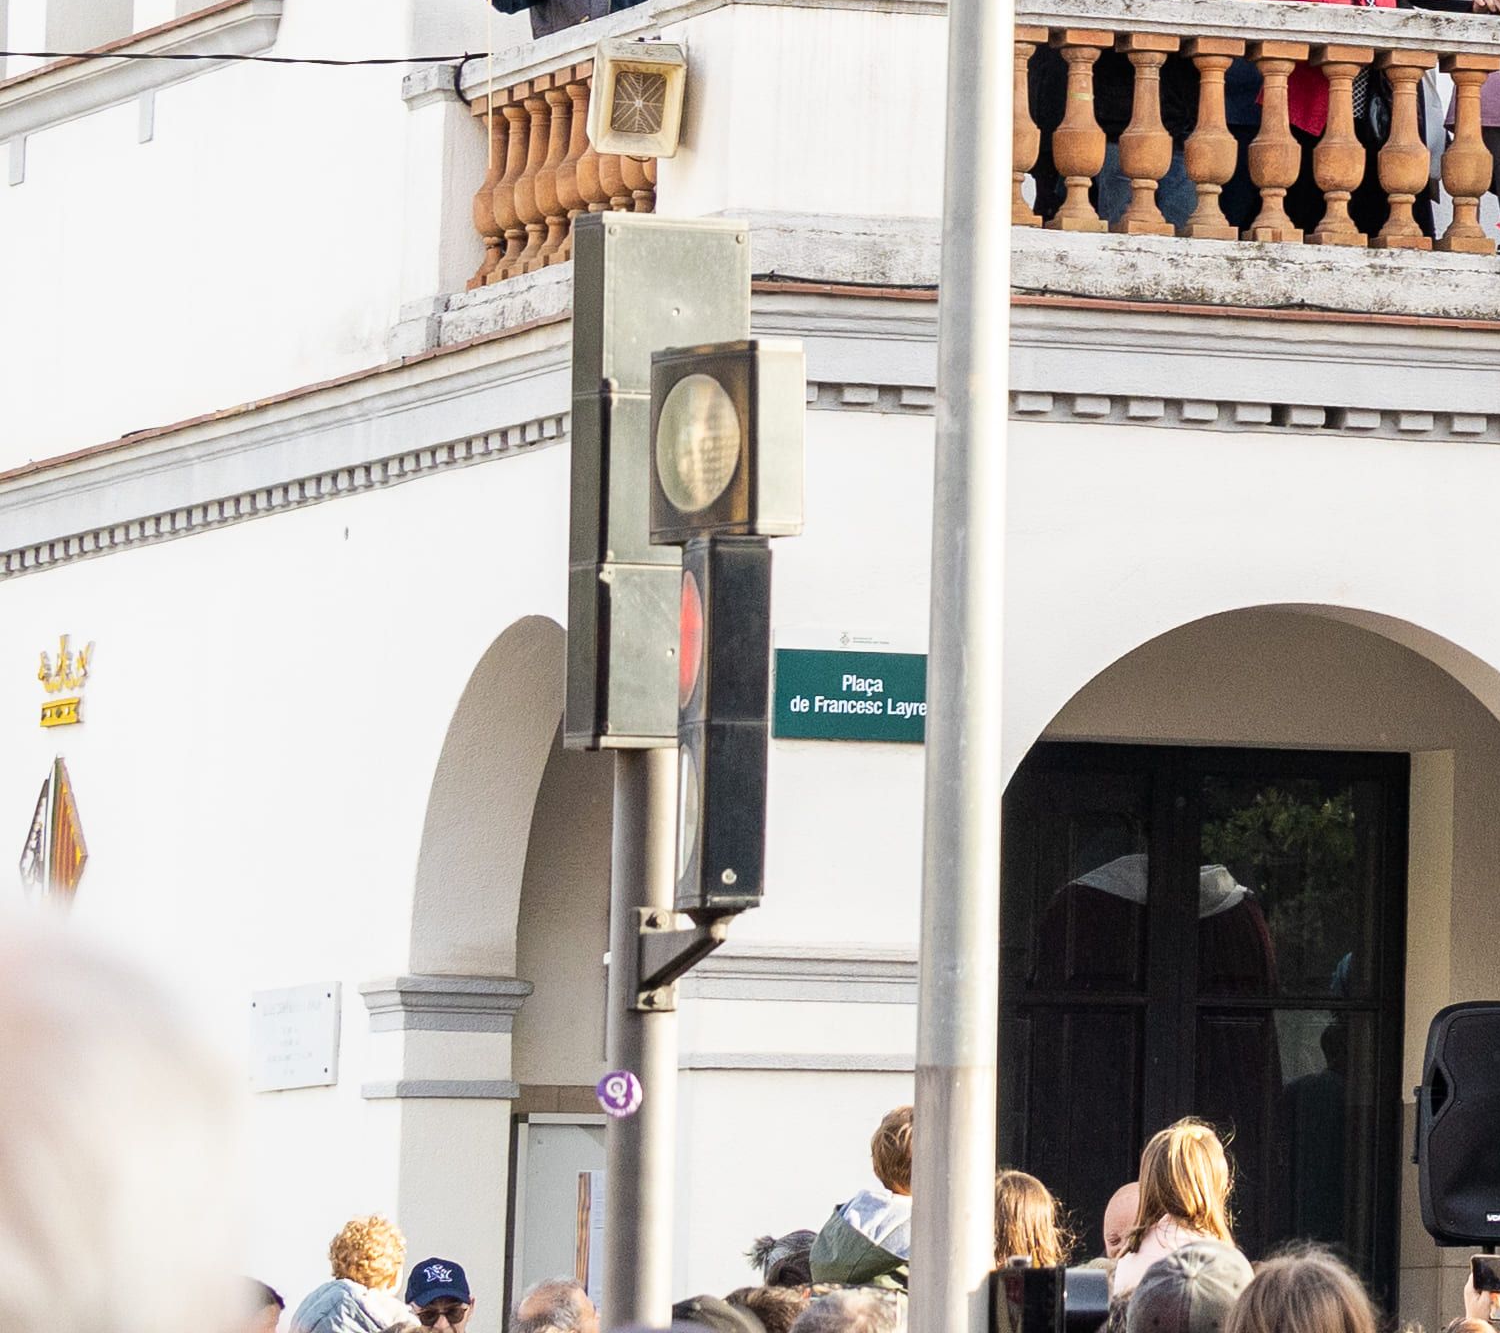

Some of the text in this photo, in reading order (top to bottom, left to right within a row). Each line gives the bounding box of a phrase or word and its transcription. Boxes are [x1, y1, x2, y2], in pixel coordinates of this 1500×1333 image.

[842, 674, 883, 697] Plaça
[790, 695, 928, 719] de Francesc Layre
